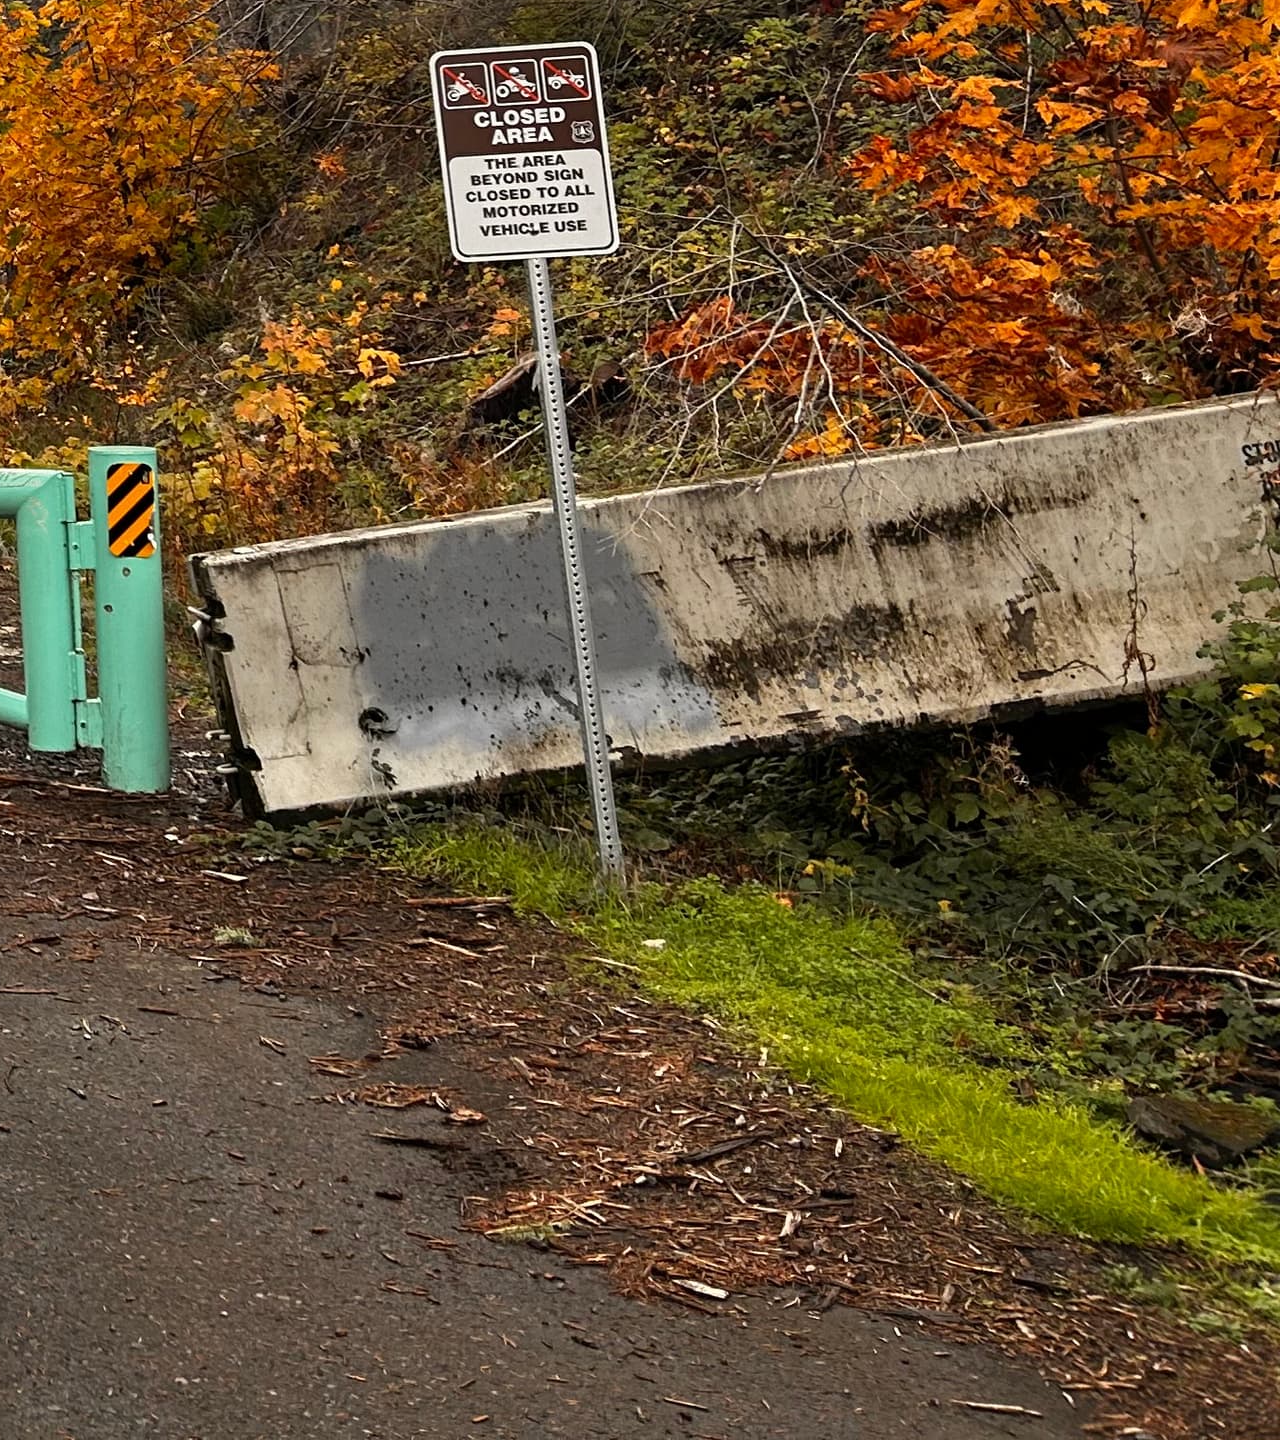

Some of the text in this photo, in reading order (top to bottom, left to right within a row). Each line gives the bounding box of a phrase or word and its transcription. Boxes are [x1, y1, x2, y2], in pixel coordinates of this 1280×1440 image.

[474, 107, 566, 128] CLOSED
[492, 127, 554, 145] AREA
[484, 154, 566, 170] THE AREA
[470, 168, 584, 186] BEYOND SIGN
[466, 183, 595, 203] CLOSED TO ALL
[483, 202, 579, 219] MOTORIZED
[480, 220, 587, 237] VEHICLE USE
